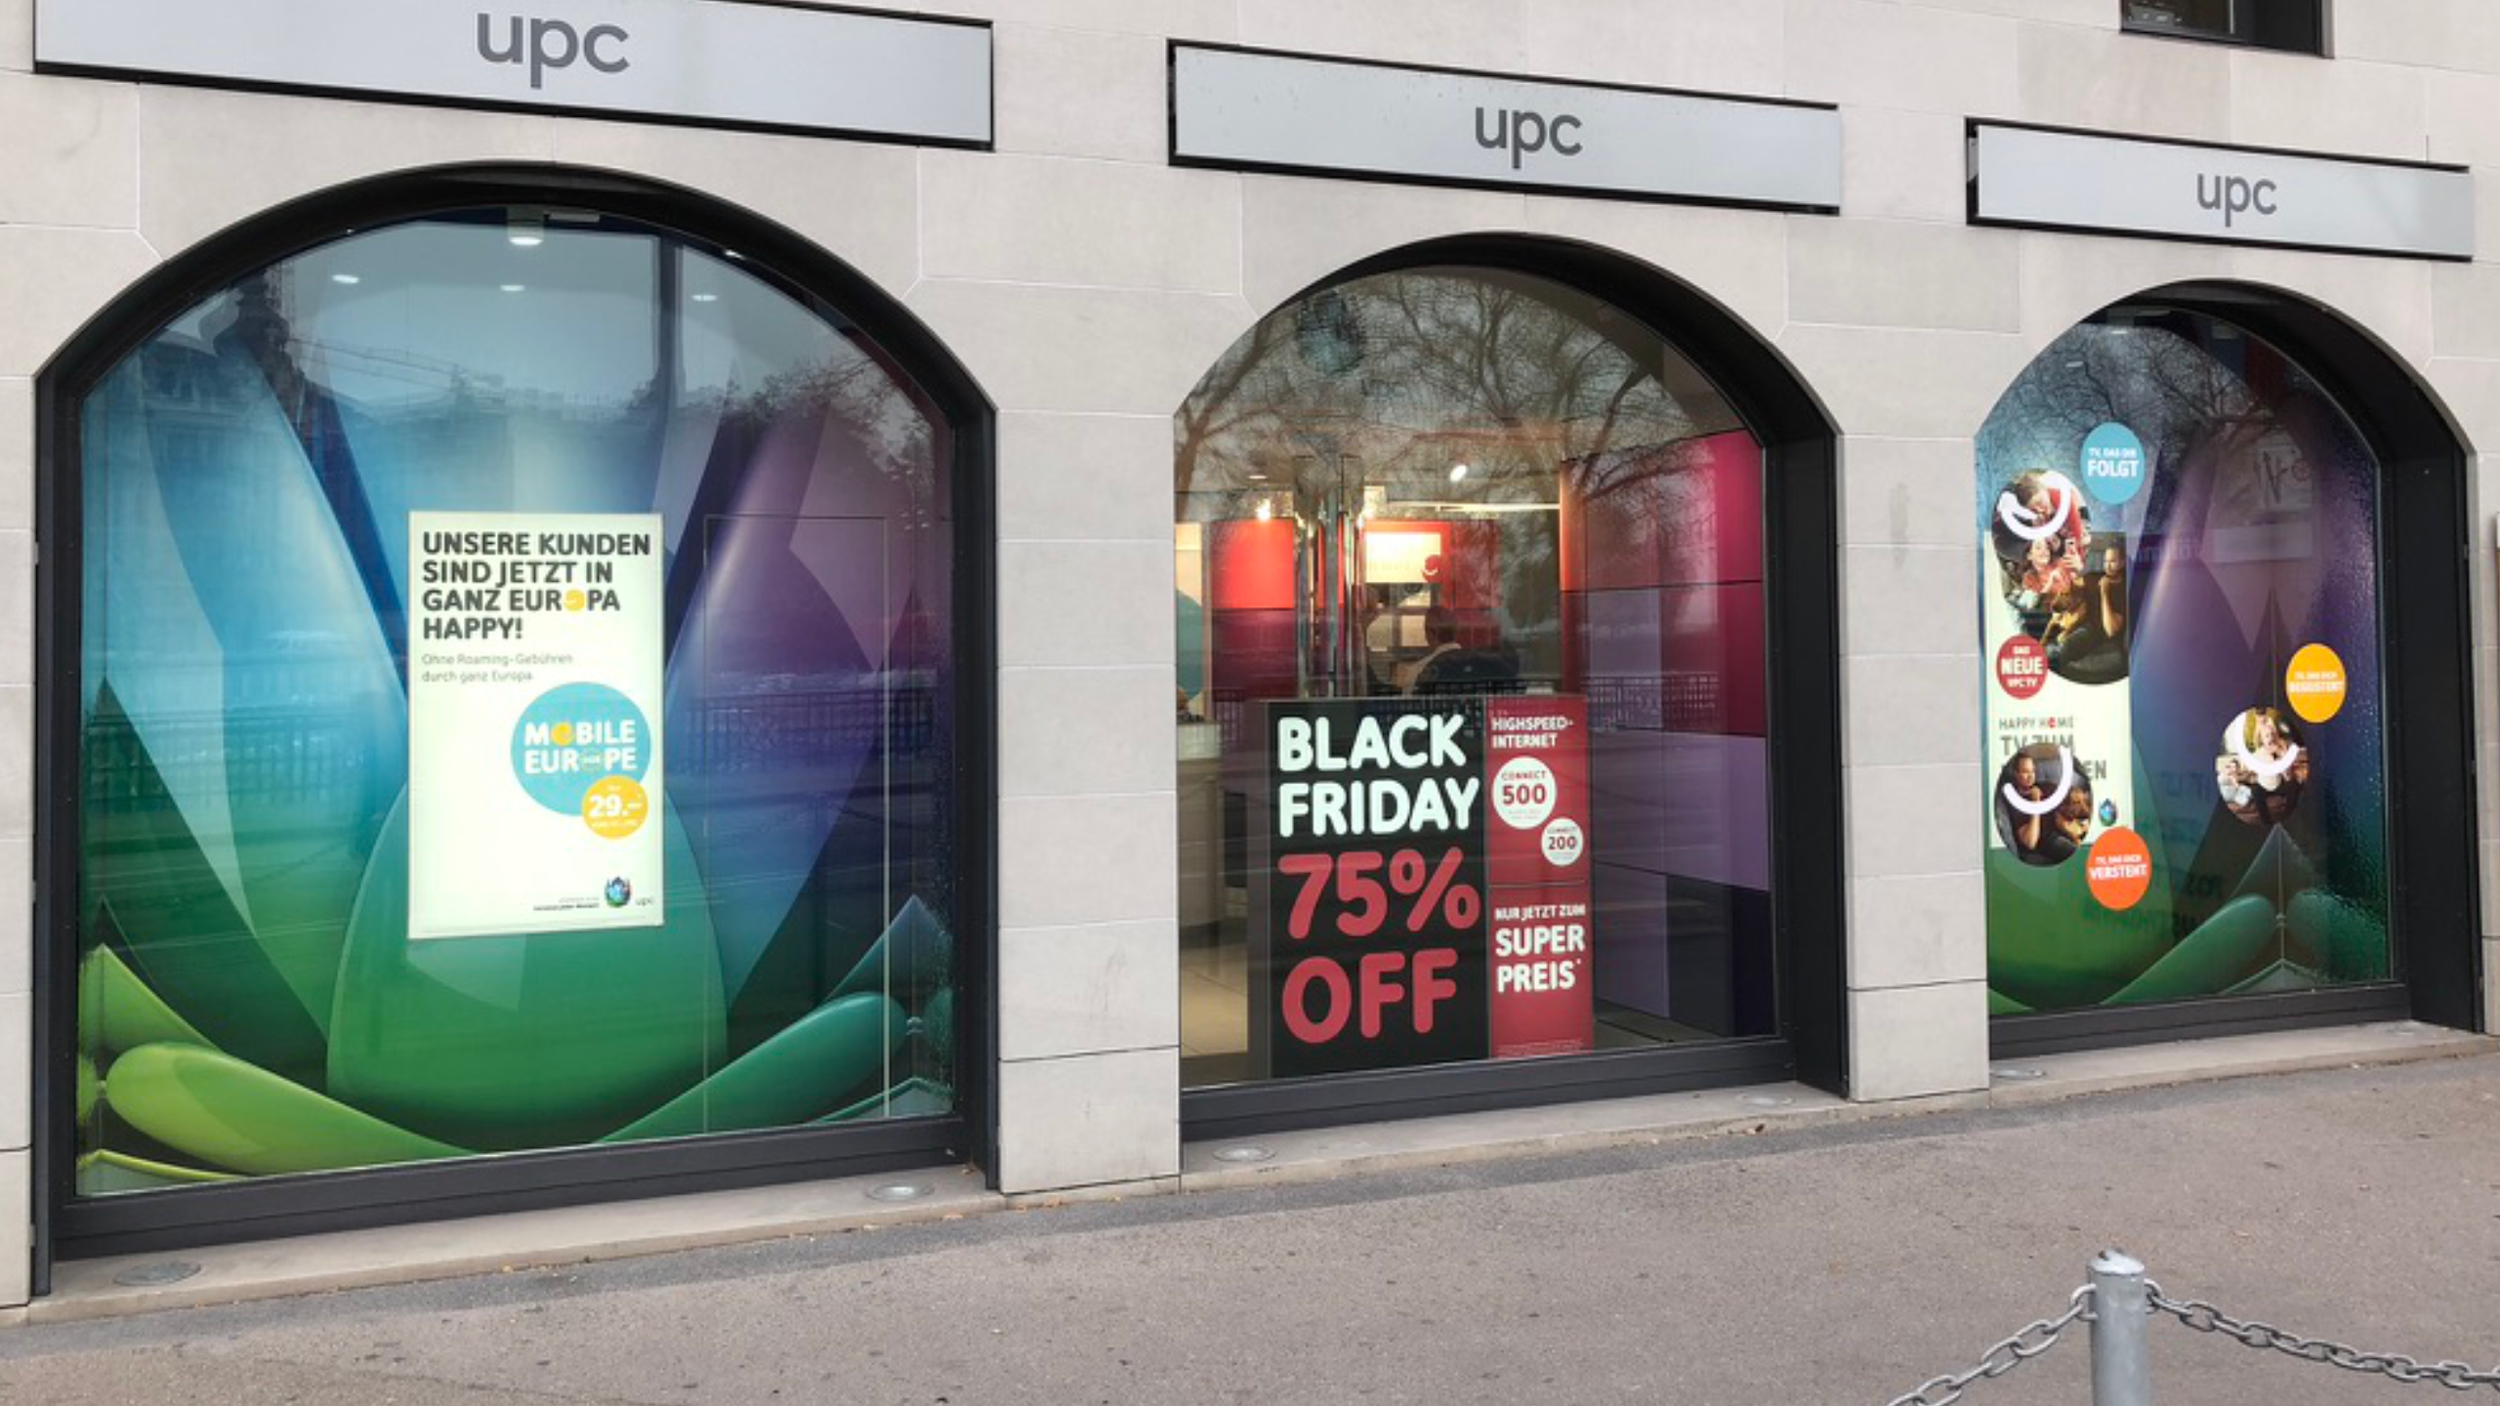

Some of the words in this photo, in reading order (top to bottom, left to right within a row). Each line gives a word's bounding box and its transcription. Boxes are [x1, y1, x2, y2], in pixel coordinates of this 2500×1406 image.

[477, 13, 630, 90] upc
[1475, 106, 1583, 170] upc
[2197, 172, 2277, 228] upc
[2087, 459, 2139, 477] FOLGT
[423, 531, 531, 555] UNSERE
[538, 533, 650, 555] KUNDEN
[422, 560, 491, 583] SIND
[495, 561, 577, 588] JETZT
[585, 562, 613, 583] IN
[422, 589, 501, 611] GANZ
[509, 588, 621, 612] EUROPA
[423, 617, 523, 640] HAPPY!
[422, 653, 454, 665] Ohne
[2001, 656, 2043, 675] NEUE
[422, 669, 455, 682] durch
[460, 672, 488, 684] ganz
[492, 669, 533, 683] Europa
[524, 719, 636, 747] MOBILE
[1491, 716, 1574, 731] HIGHSPEED-
[1999, 716, 2036, 730] HAPPY
[1277, 714, 1467, 772] BLACK
[1491, 733, 1558, 748] INTERNET
[1501, 770, 1547, 781] CONNECT
[1502, 784, 1547, 806] 500
[1278, 777, 1480, 838] FRIDAY
[1548, 835, 1578, 850] 200
[2090, 863, 2148, 880] VERSTEHT
[1277, 847, 1481, 940] 75%
[1494, 907, 1520, 920] NUR
[1521, 904, 1557, 921] JETZT
[1559, 904, 1586, 917] ZUM
[1495, 924, 1586, 957] SUPER
[1281, 948, 1458, 1044] OFF
